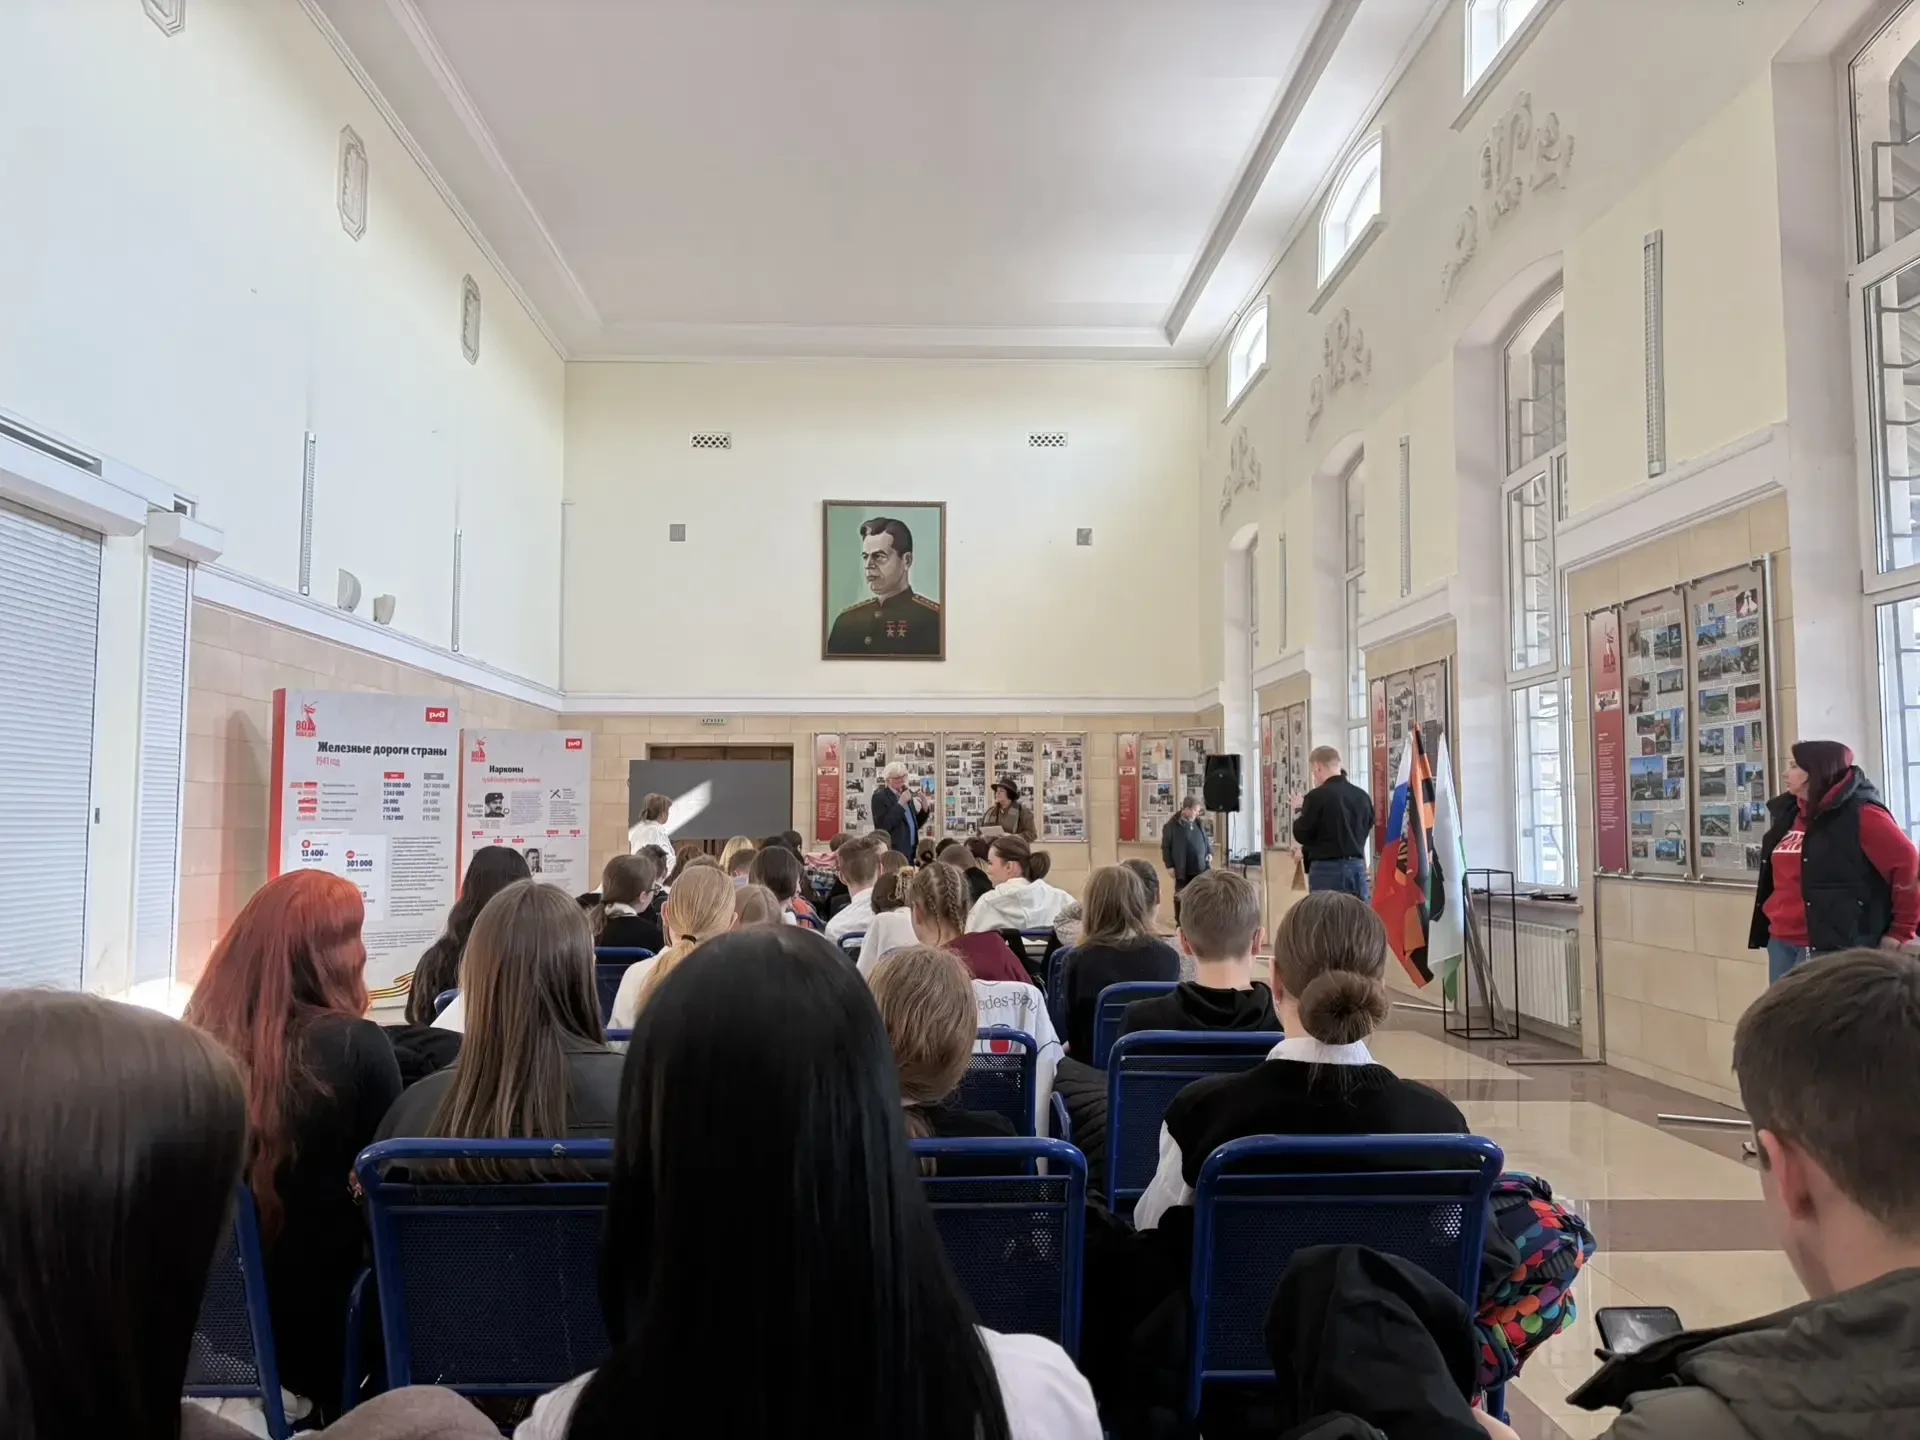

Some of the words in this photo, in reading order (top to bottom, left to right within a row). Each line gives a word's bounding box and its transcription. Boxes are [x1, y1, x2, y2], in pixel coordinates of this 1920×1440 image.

[317, 741, 372, 754] Железные
[373, 744, 409, 757] дороги
[411, 746, 447, 758] страны
[316, 756, 329, 766] 1941
[489, 764, 524, 775] Наркомы
[301, 849, 309, 857] 13
[346, 860, 359, 868] 301
